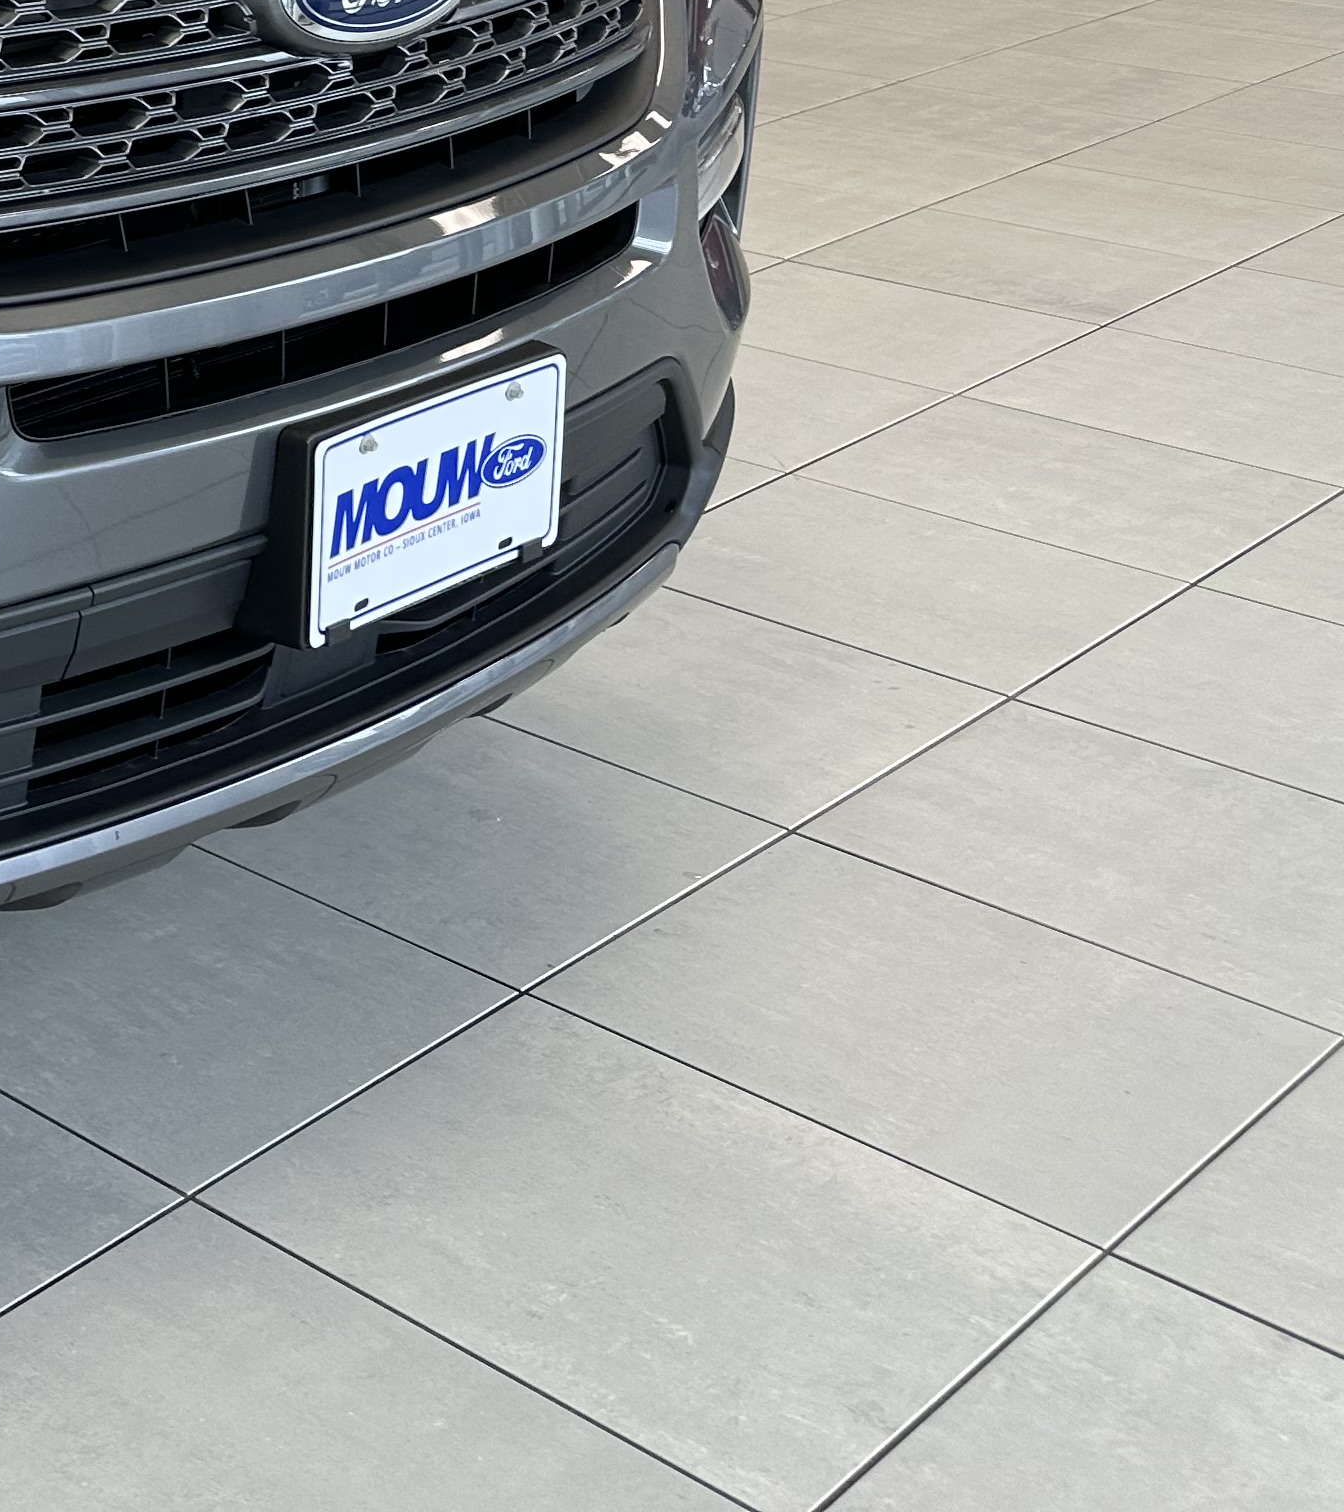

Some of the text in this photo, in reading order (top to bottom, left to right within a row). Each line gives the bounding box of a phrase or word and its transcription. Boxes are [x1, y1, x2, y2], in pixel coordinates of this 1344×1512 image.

[327, 564, 352, 583] MOUW
[354, 550, 381, 571] MOTOR
[383, 544, 394, 557] CO
[402, 531, 426, 550] SIOUX
[461, 508, 481, 526] IOWA
[329, 431, 497, 560] MOUW
